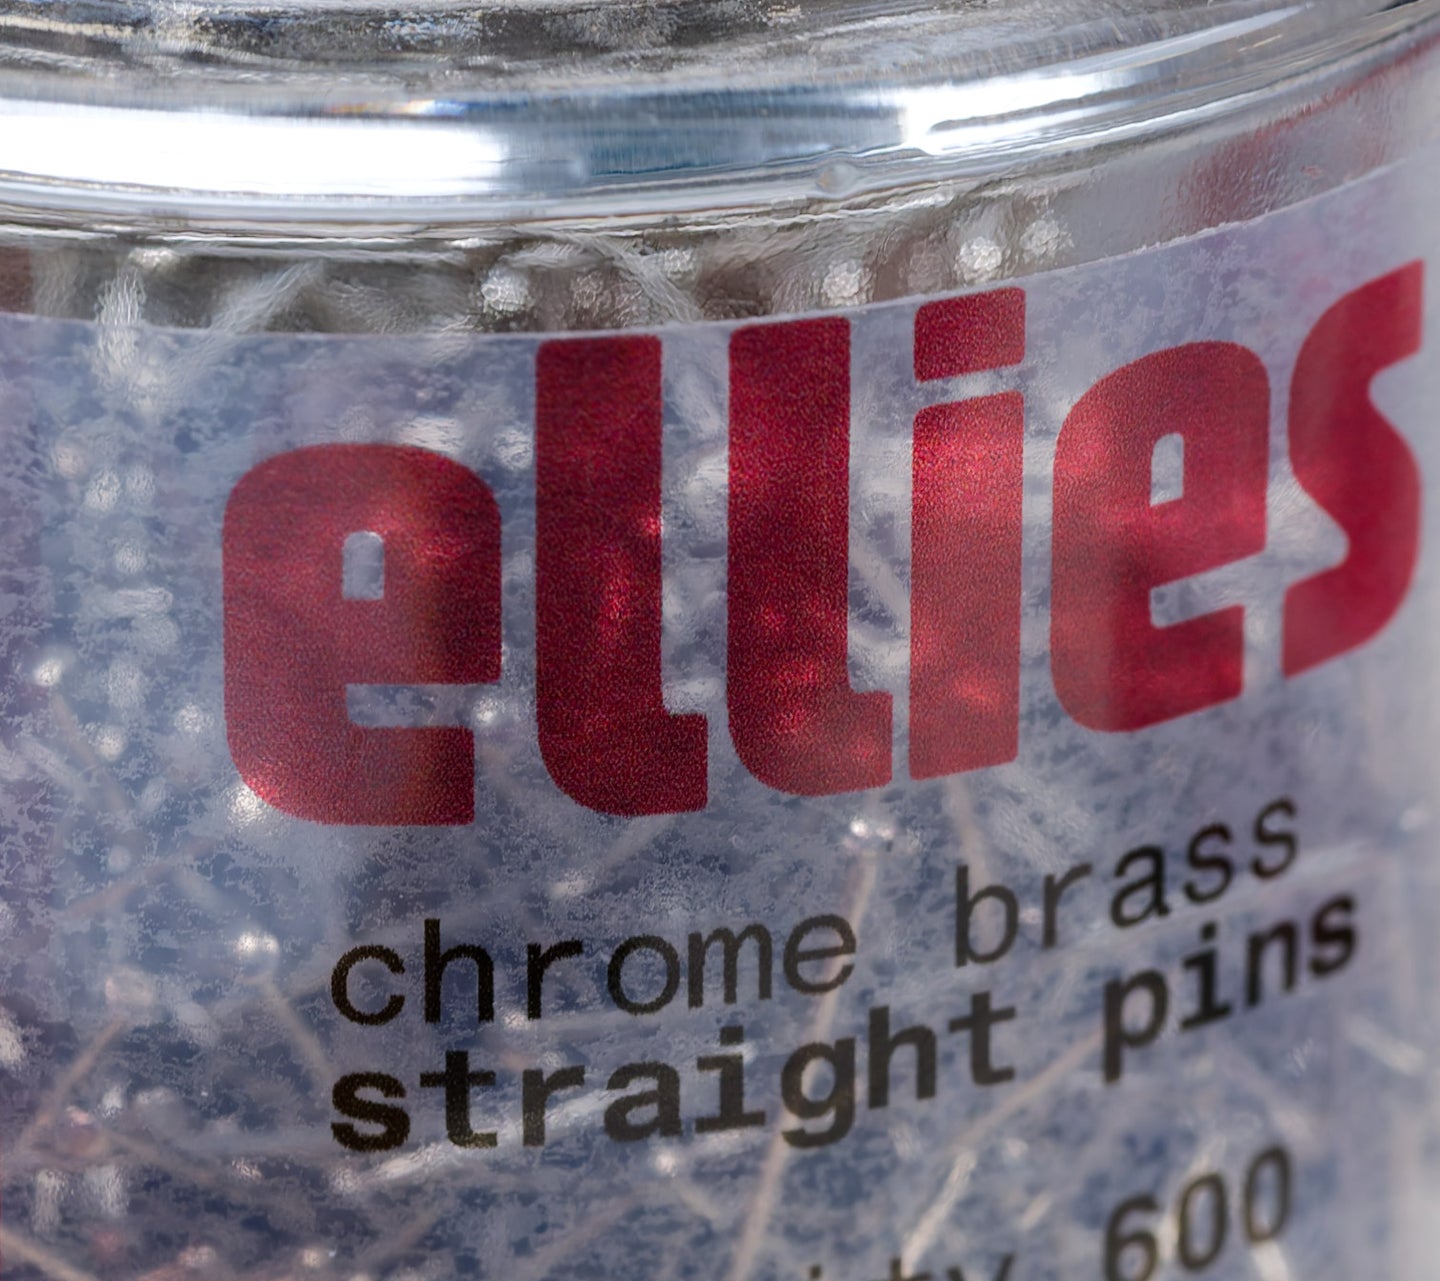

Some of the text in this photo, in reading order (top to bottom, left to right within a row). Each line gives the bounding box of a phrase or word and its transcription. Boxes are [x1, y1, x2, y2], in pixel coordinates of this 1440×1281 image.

[220, 257, 1426, 828] ellies
[329, 795, 1300, 1028] chrome brass
[330, 892, 1358, 1154] straight pins
